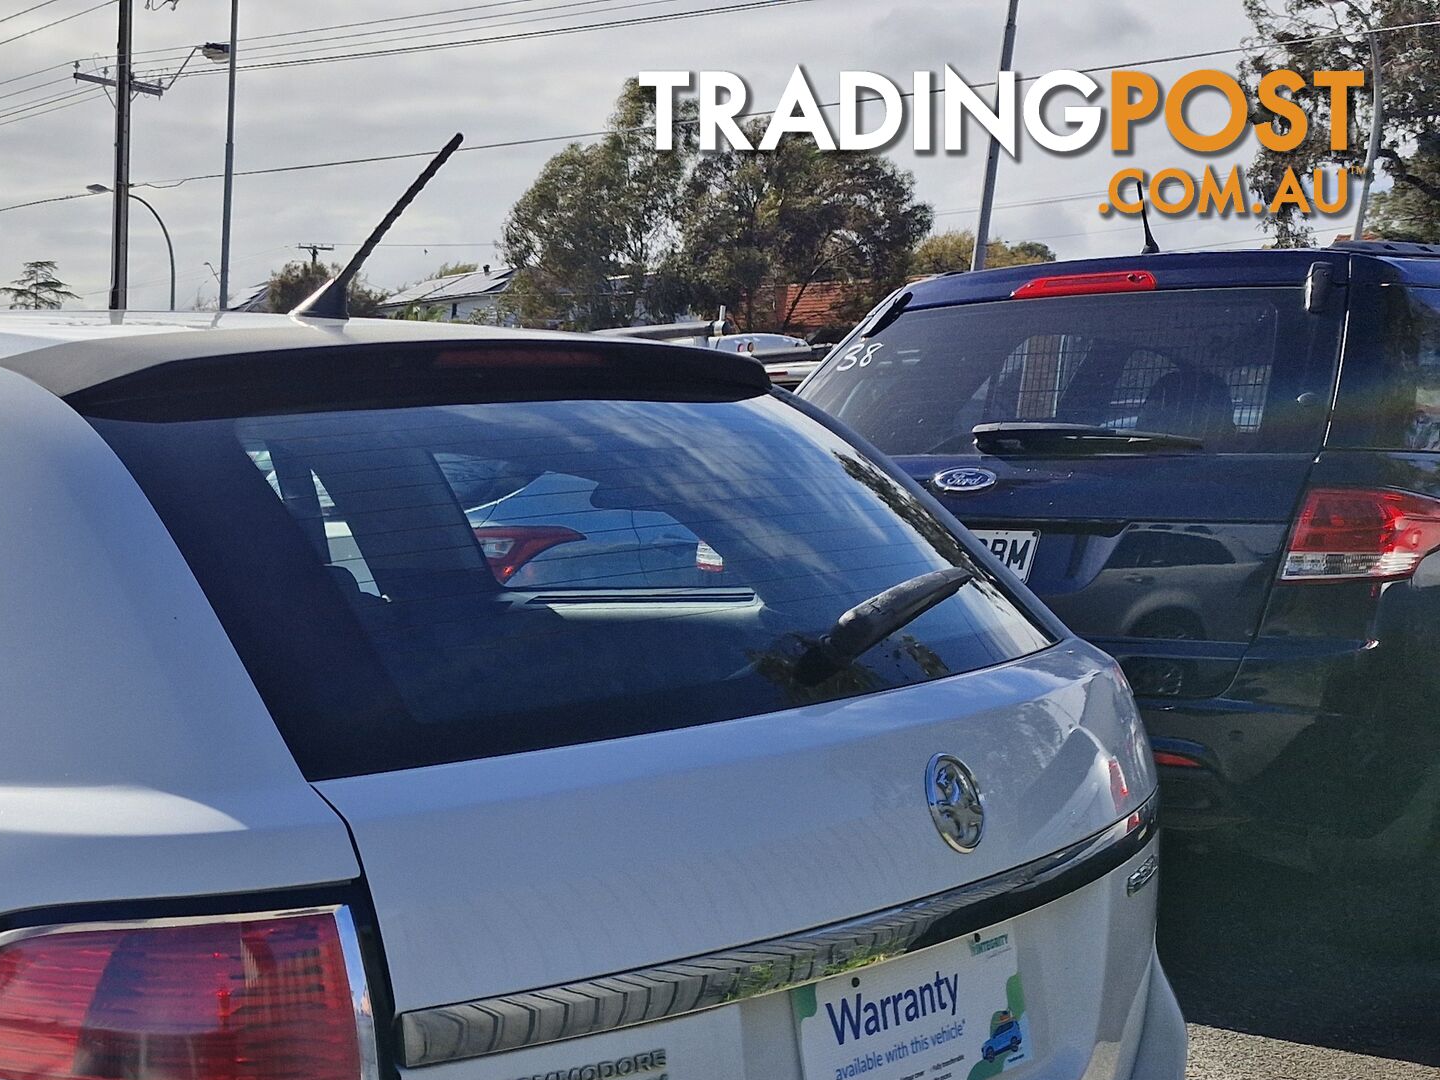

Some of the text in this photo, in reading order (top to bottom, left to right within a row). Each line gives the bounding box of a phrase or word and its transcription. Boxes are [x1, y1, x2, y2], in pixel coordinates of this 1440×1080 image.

[946, 471, 982, 486] Ford
[825, 970, 959, 1046] Warranty
[885, 1040, 909, 1064] with
[910, 1034, 929, 1055] this
